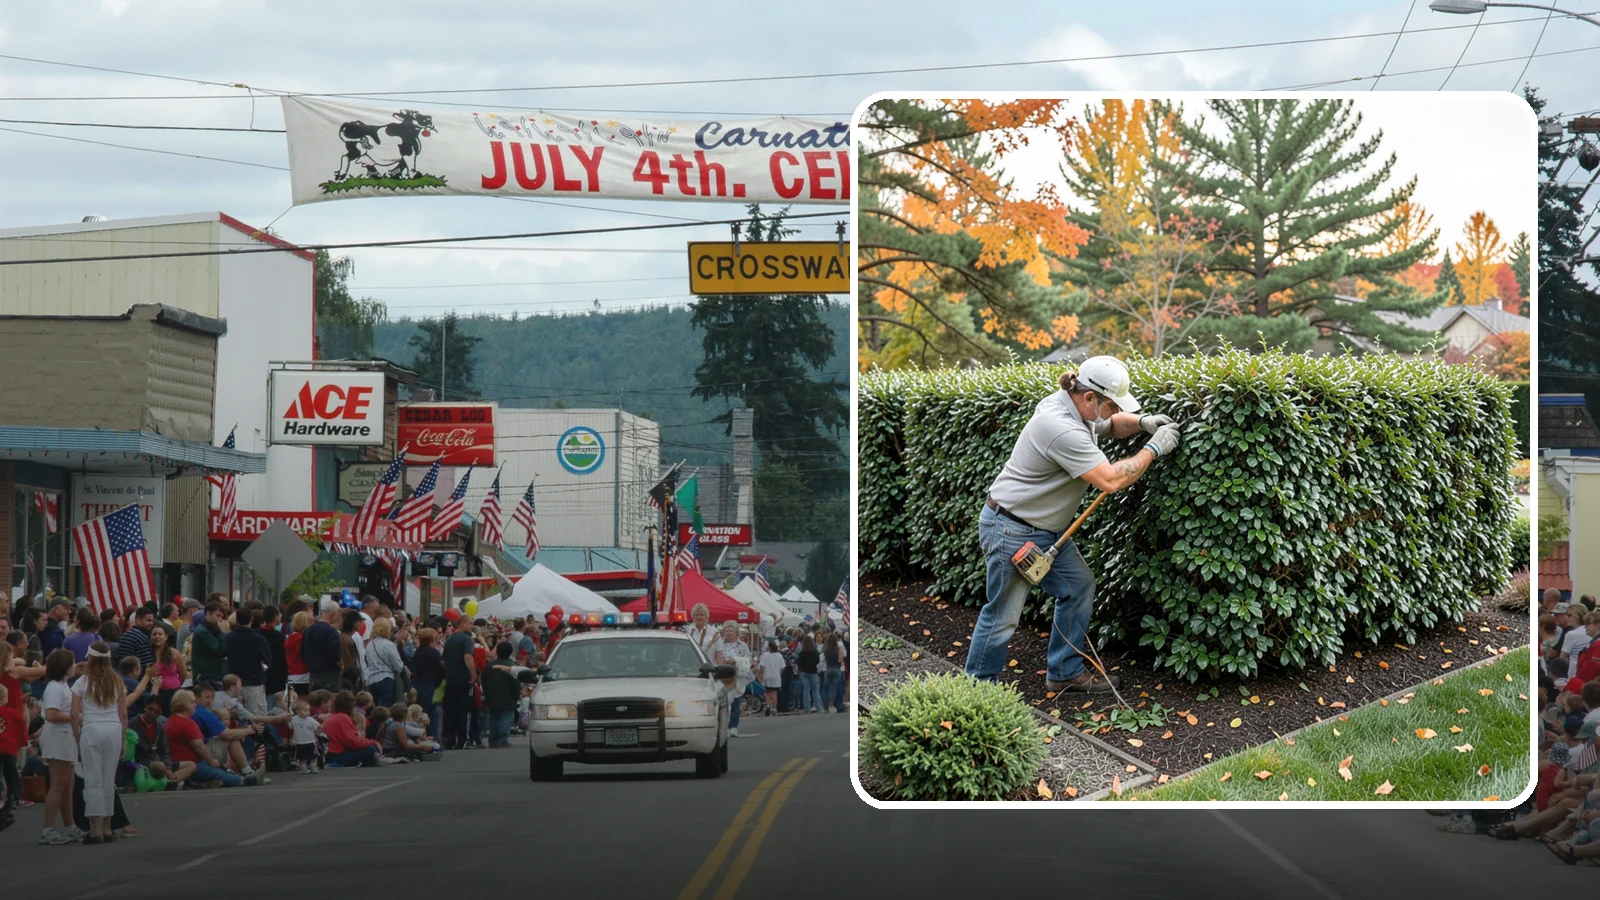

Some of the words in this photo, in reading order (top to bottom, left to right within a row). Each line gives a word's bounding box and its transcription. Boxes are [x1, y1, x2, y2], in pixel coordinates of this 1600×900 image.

[481, 141, 605, 192] JULY
[632, 150, 746, 197] 4th.
[697, 254, 850, 280] CROSSWA
[282, 380, 373, 420] ACE
[405, 410, 452, 421] CEDAR
[283, 421, 370, 436] Hardware
[416, 428, 477, 447] Coca-Cola
[83, 485, 93, 494] St.
[96, 485, 124, 494] Vincent
[126, 486, 136, 494] de
[138, 486, 155, 495] Paul
[212, 516, 330, 535] HARDARE
[699, 535, 730, 543] GLASS
